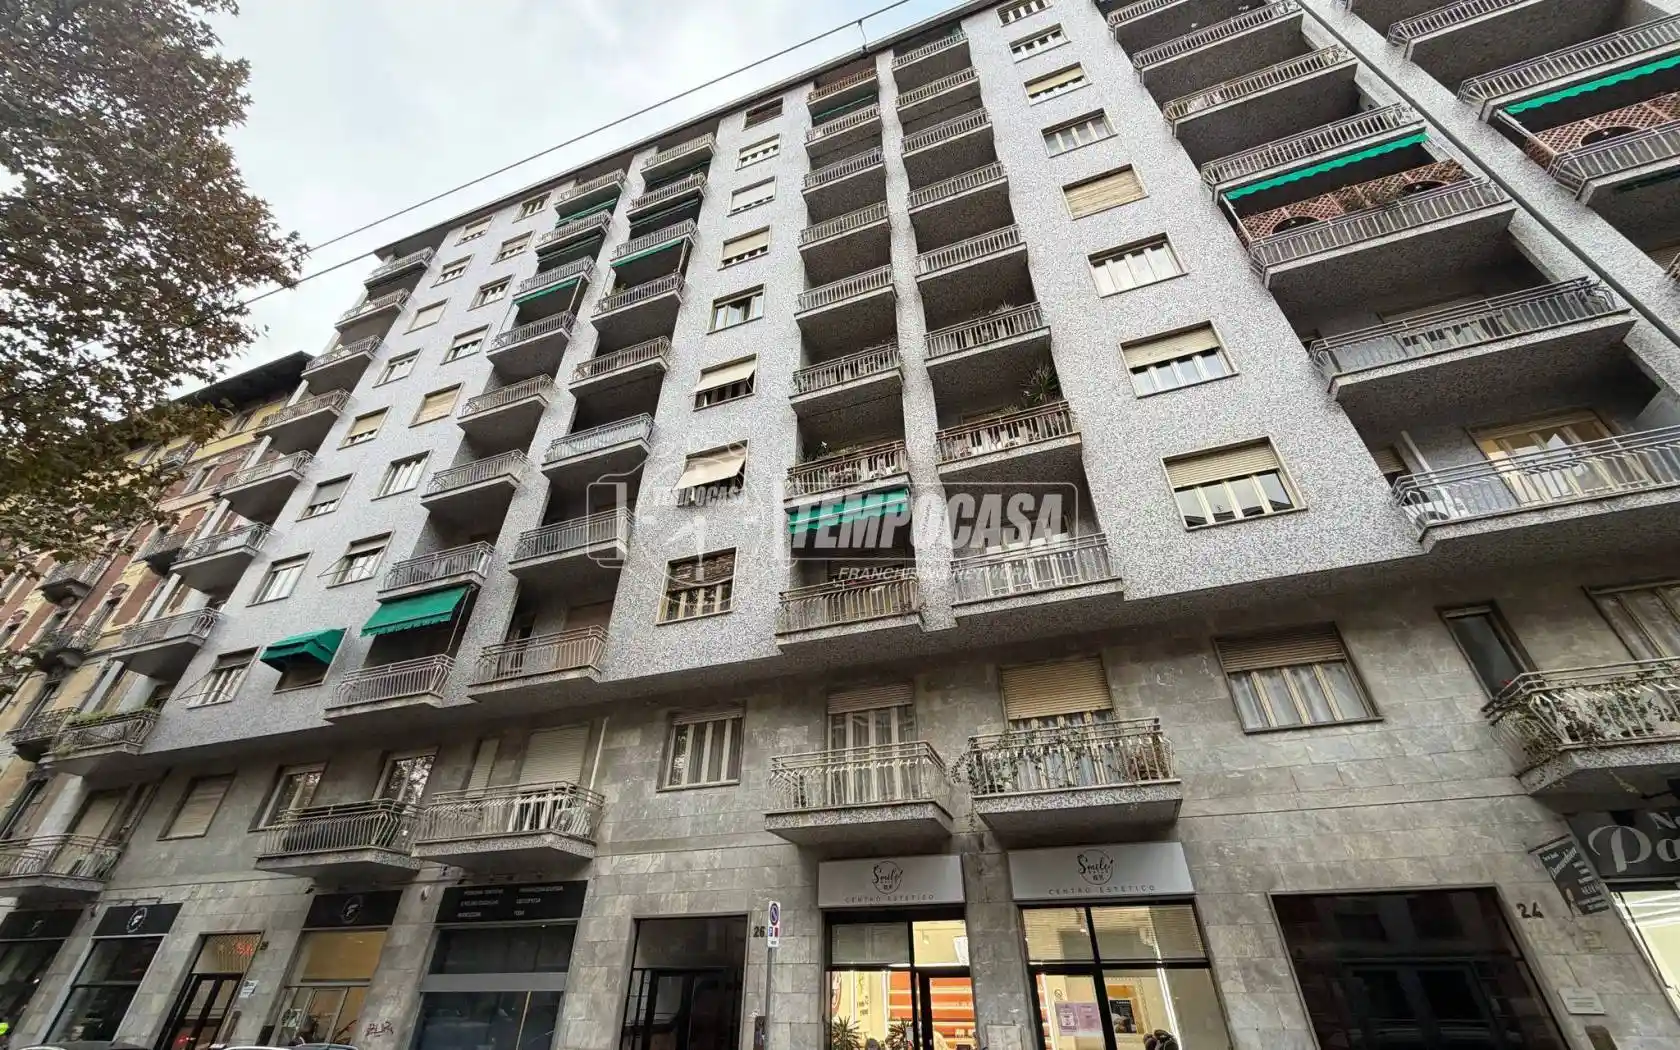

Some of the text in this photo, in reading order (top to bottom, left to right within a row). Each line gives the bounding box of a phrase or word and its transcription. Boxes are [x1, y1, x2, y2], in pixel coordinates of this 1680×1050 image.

[1077, 853, 1112, 873] Smile
[872, 865, 902, 883] Smile
[1047, 884, 1156, 896] CENTRO ESTETICO
[843, 893, 935, 904] CENTRO ESTETICO
[1516, 902, 1544, 919] 24
[753, 925, 766, 938] 26
